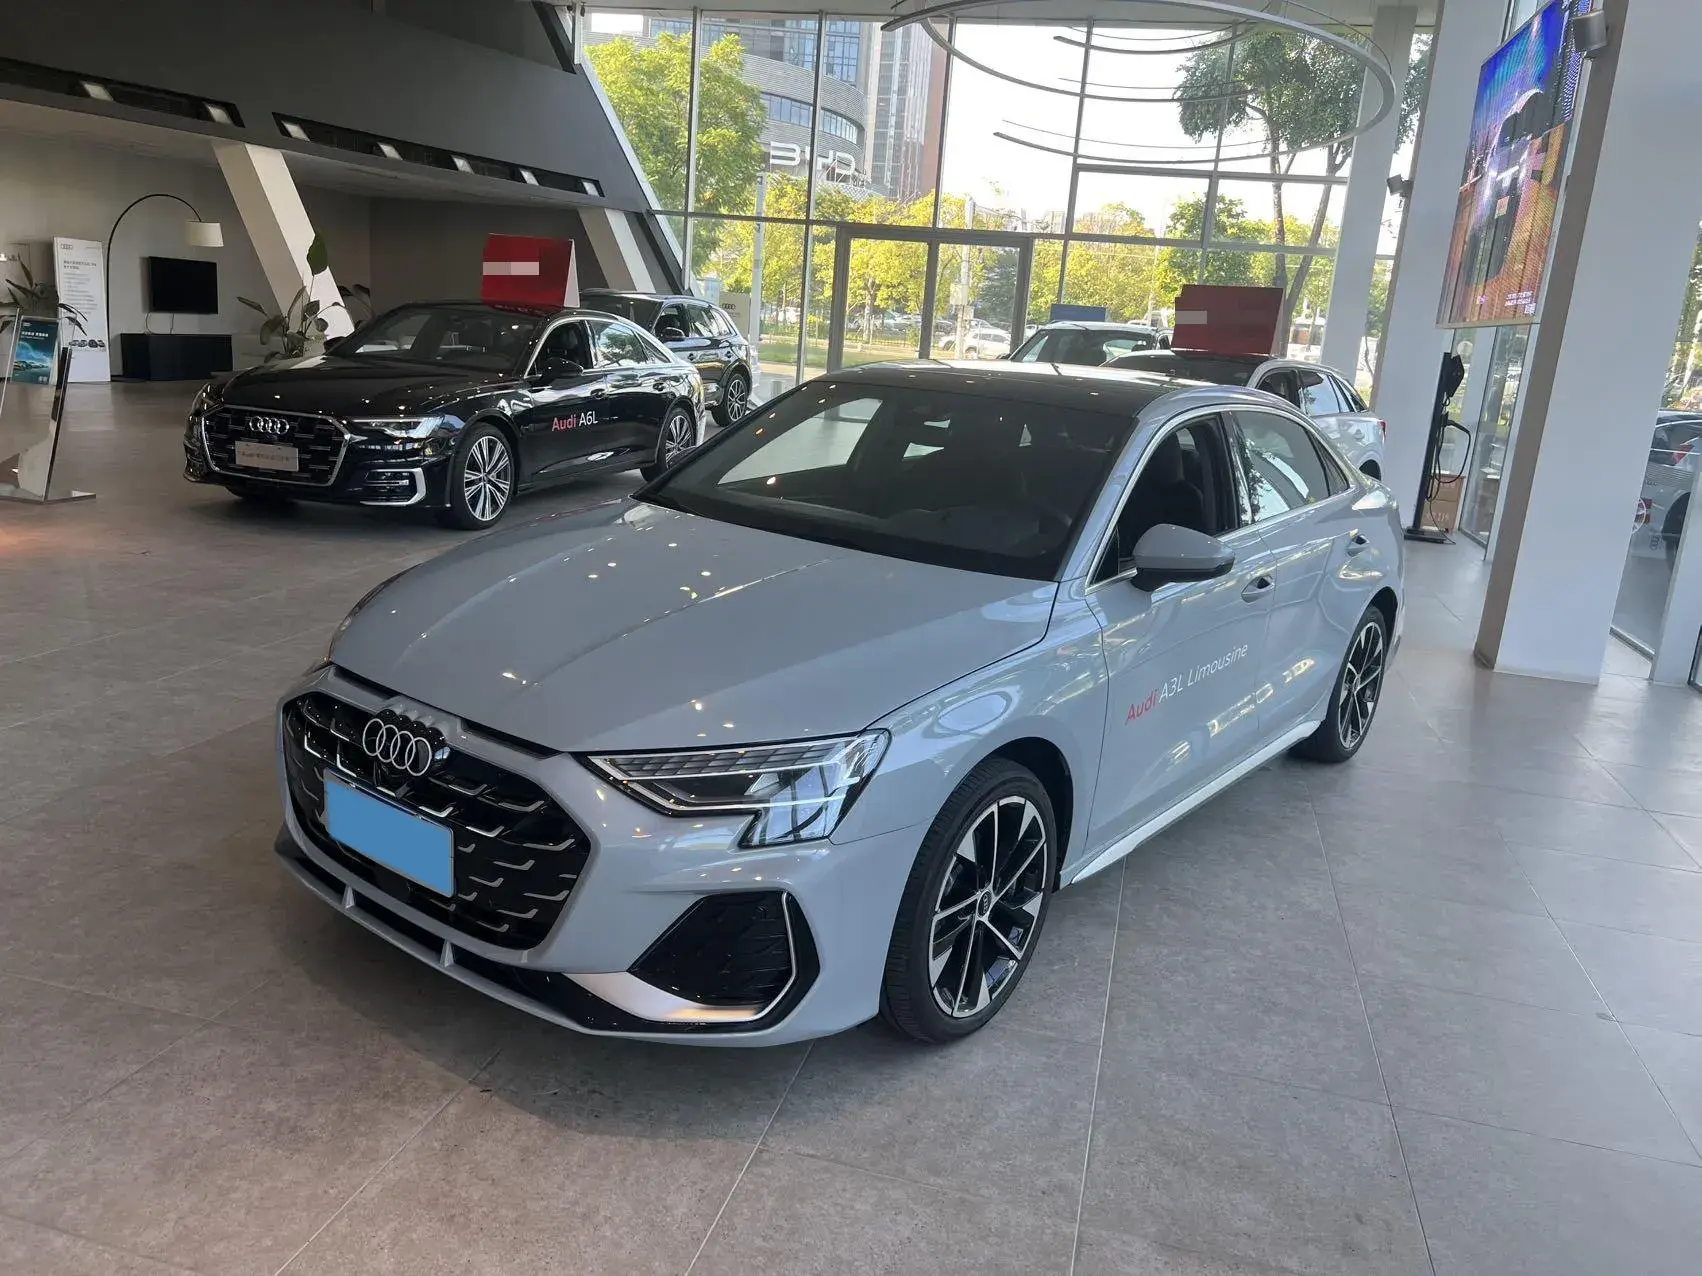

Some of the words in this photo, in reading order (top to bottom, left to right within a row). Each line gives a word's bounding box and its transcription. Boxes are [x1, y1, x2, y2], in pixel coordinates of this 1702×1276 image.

[552, 414, 577, 431] Audi
[579, 411, 599, 426] A6L
[1125, 688, 1159, 725] Audi
[1159, 673, 1184, 703] A3L
[1187, 644, 1249, 687] Limousine
